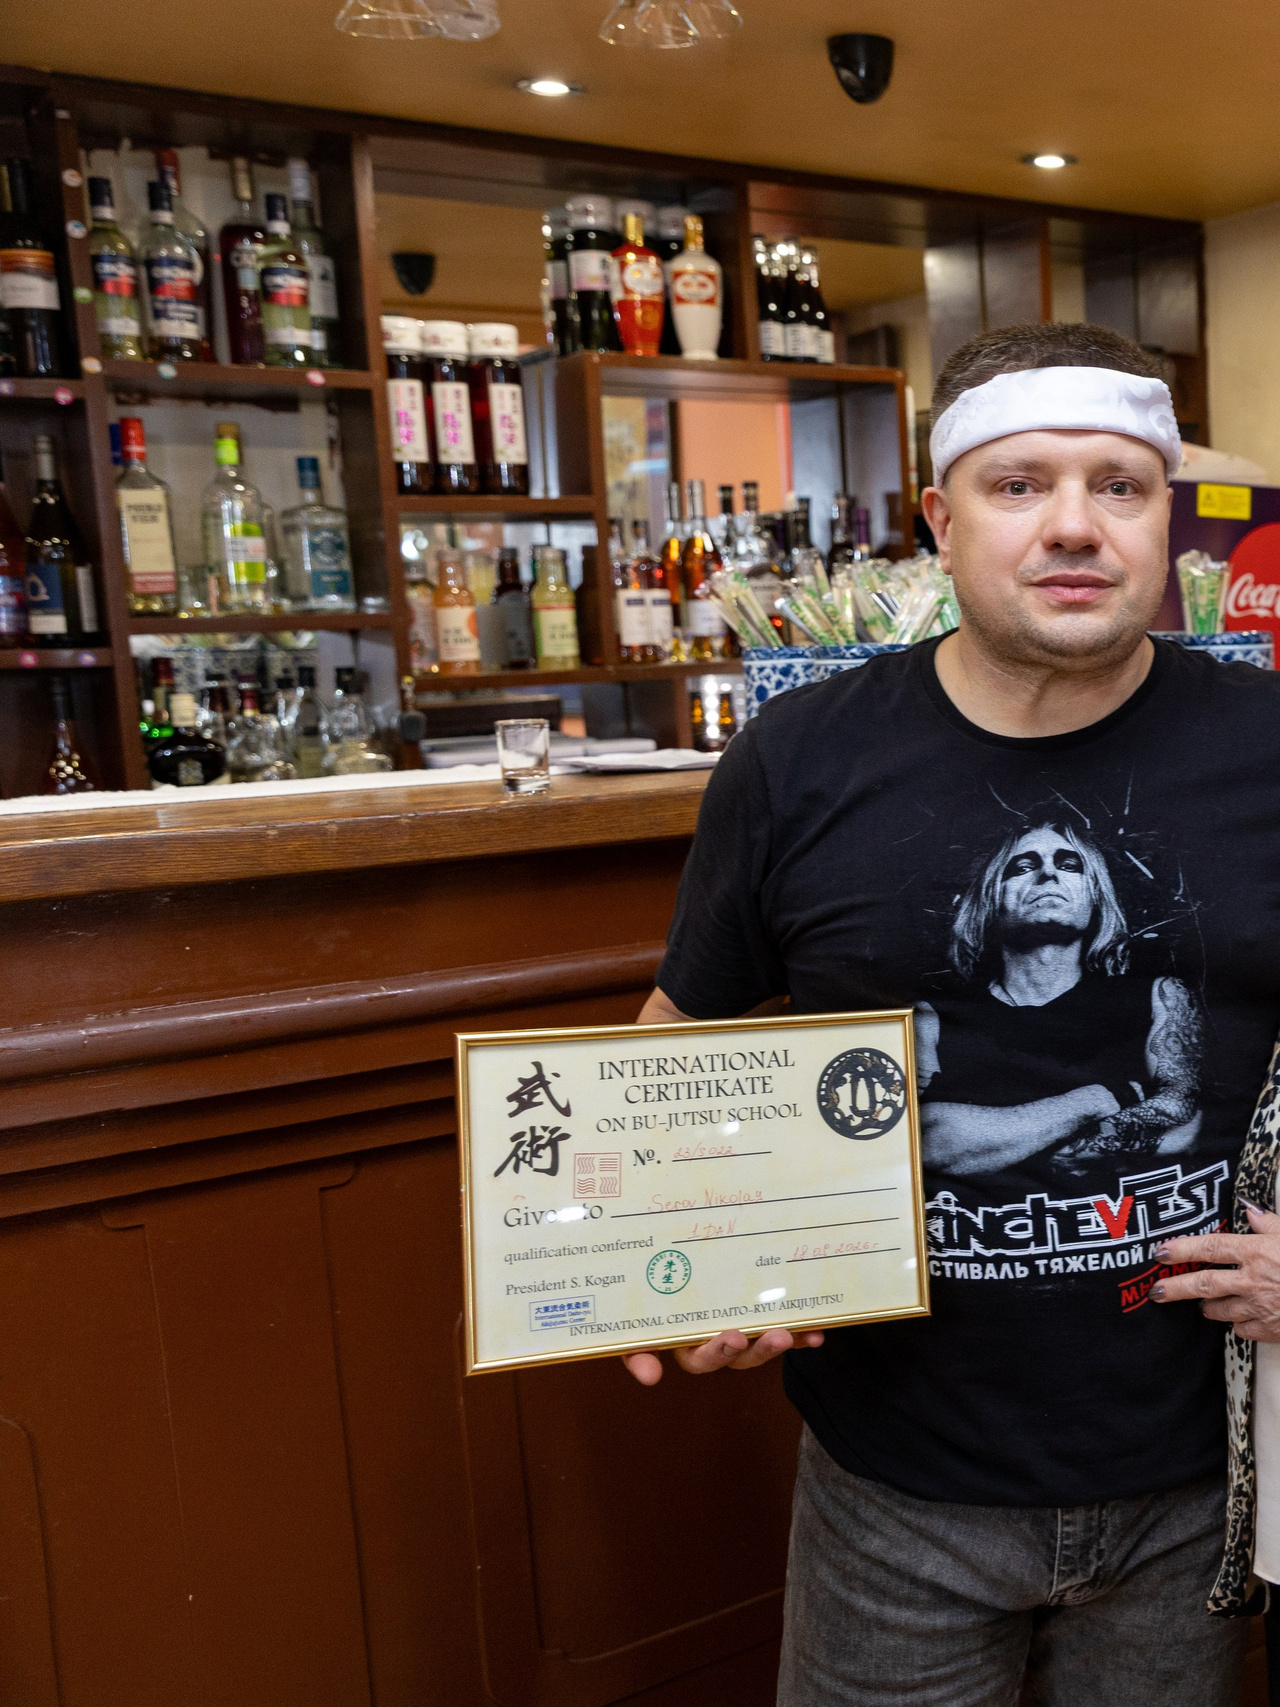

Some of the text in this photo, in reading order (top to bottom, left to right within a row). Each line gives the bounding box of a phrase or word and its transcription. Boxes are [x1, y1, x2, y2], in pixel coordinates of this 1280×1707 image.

[598, 1049, 796, 1081] INTERNATIONAL
[625, 1075, 774, 1104] CERTIFIKATE
[596, 1103, 802, 1133] ON BU-JUTSU SCHOOL
[503, 1207, 574, 1228] Give
[504, 1243, 588, 1264] qualification
[591, 1236, 654, 1253] conferred
[755, 1256, 781, 1267] date
[929, 1259, 1029, 1280] СТИВАЛЬ
[1035, 1243, 1144, 1276] ТЯЖЕЛОЙ
[505, 1273, 626, 1295] President S. Kogan
[534, 1312, 567, 1321] International
[570, 1293, 844, 1337] INTERNATIONAL CENTRE DAITO-RYU AIKIJUJUTSU
